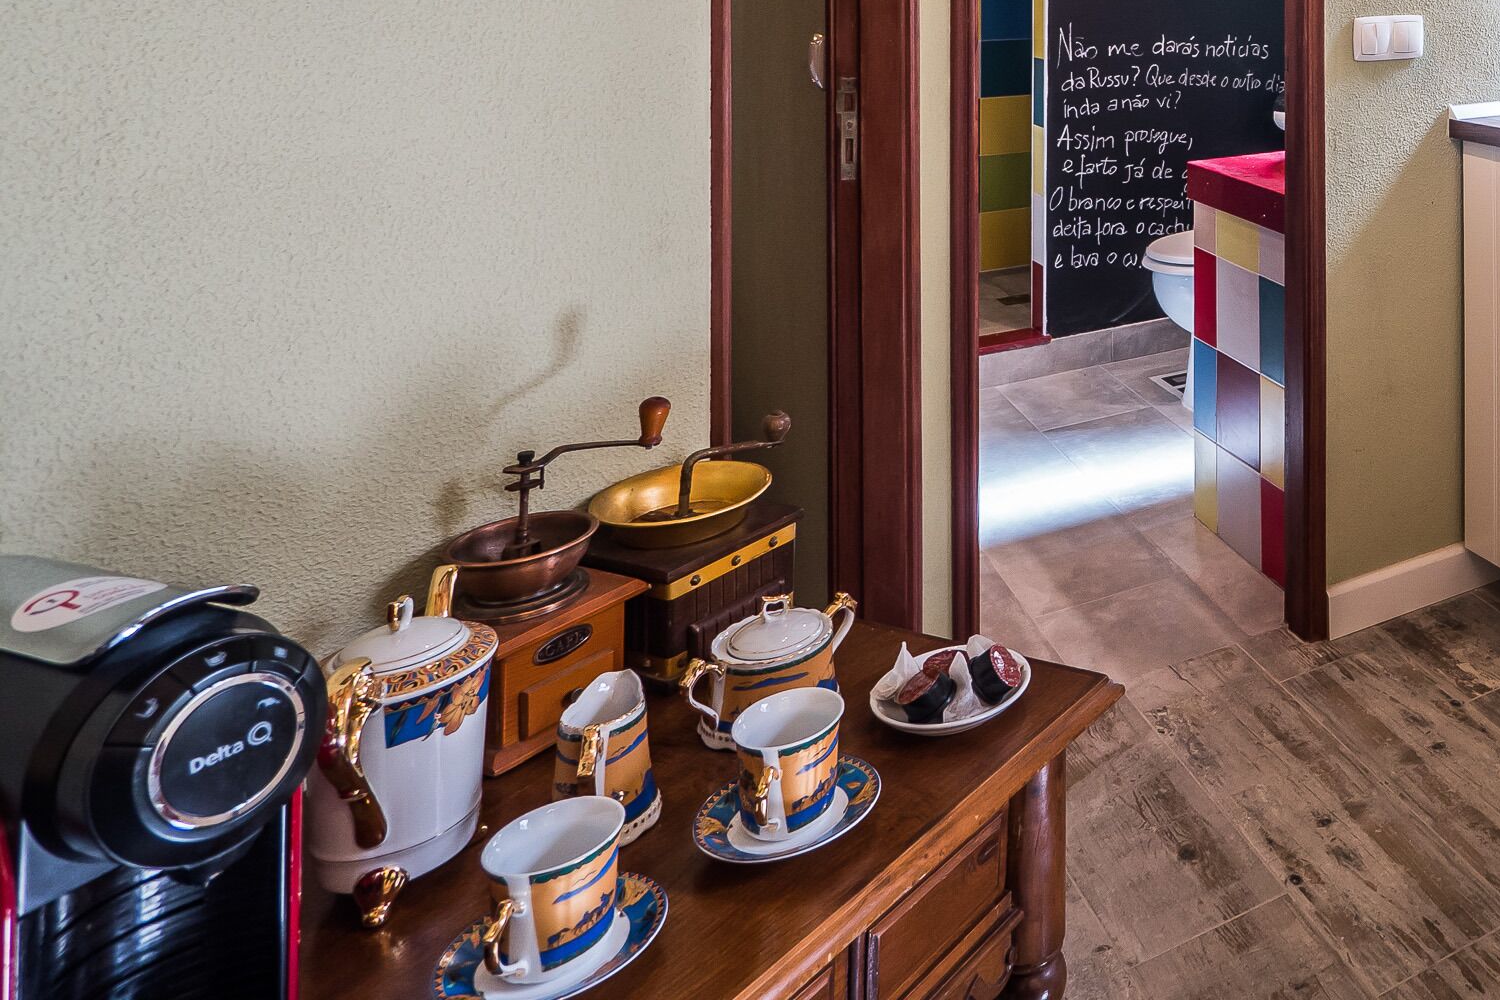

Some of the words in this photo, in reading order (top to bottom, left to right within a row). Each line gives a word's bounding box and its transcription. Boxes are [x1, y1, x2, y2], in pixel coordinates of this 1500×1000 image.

[1056, 21, 1098, 70] Não
[1107, 43, 1144, 57] me
[1151, 33, 1200, 58] darás
[1061, 71, 1086, 92] da
[1145, 63, 1176, 88] Que
[1178, 67, 1217, 88] desde
[1220, 76, 1229, 88] o
[1232, 69, 1262, 92] outro
[1156, 90, 1182, 110] vi?
[1056, 123, 1115, 152] Assim
[1061, 158, 1074, 174] e
[1074, 153, 1118, 190] farto
[1151, 159, 1174, 180] de
[1068, 185, 1122, 212] branco
[1126, 198, 1136, 211] e
[1052, 215, 1092, 240] deita
[1094, 217, 1128, 246] fora
[1135, 221, 1146, 235] o
[1054, 252, 1064, 269] e
[1070, 244, 1100, 269] lava
[1106, 251, 1118, 265] o
[189, 740, 245, 775] Delta
[247, 721, 273, 746] Q
